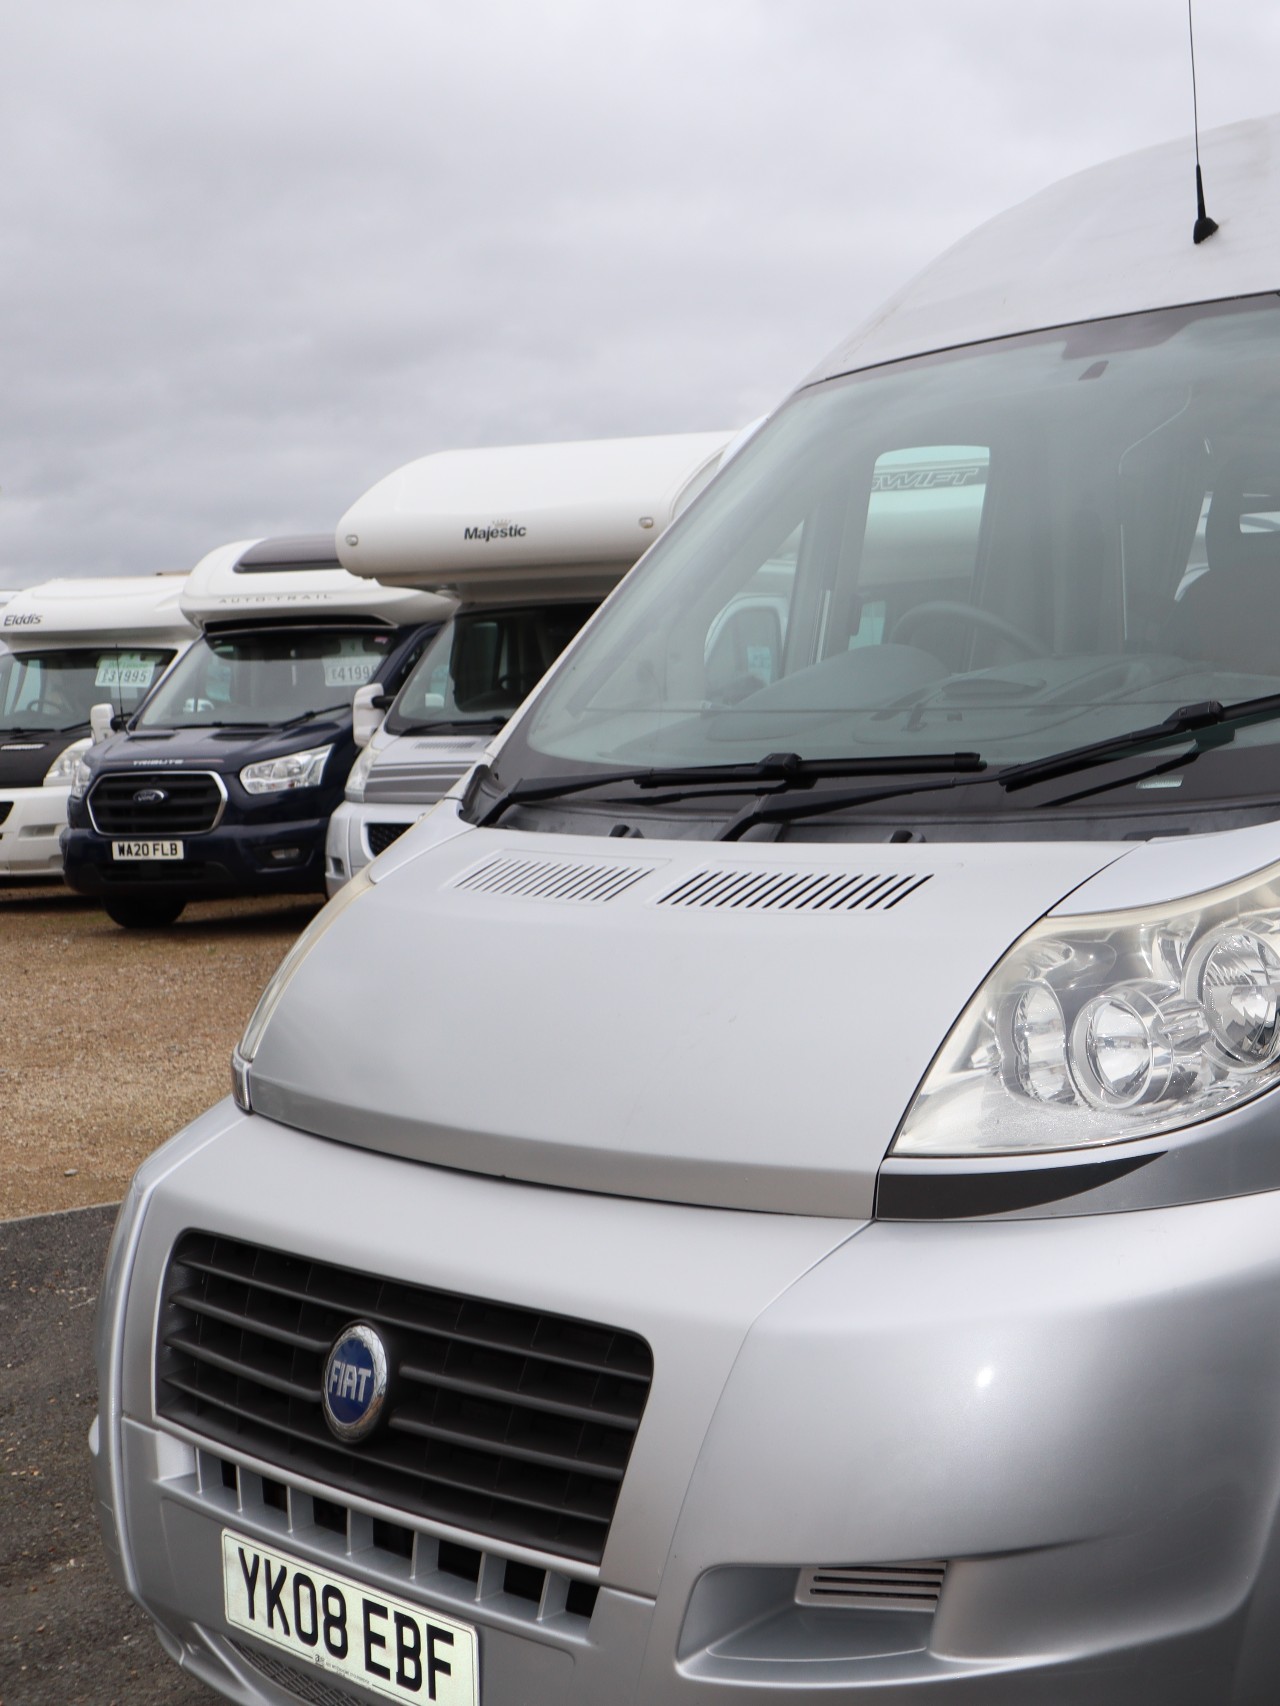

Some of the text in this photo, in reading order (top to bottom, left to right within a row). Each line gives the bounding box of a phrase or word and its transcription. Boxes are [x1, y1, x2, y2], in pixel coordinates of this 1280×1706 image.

[464, 525, 526, 542] Majestic
[4, 614, 43, 626] Elddis
[118, 842, 178, 856] WA20 FLB
[329, 1360, 371, 1403] FIAT
[238, 1547, 454, 1701] YK08 EBF
